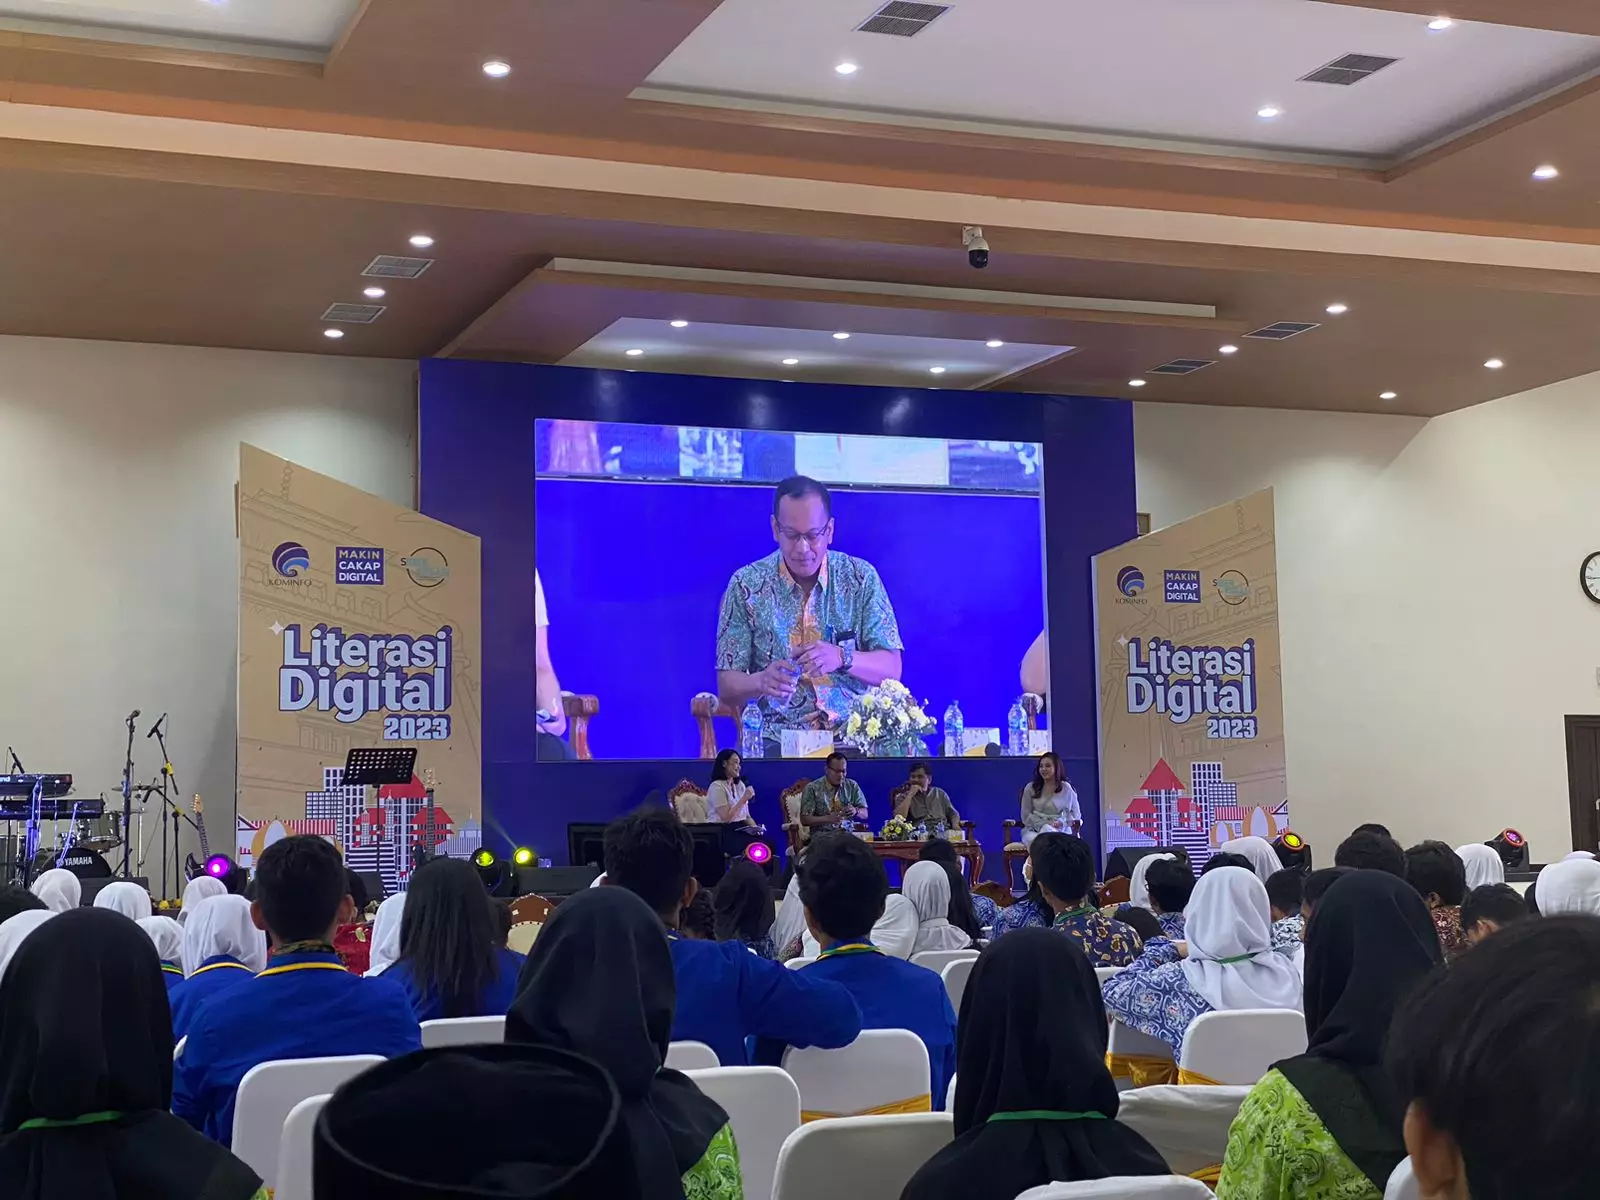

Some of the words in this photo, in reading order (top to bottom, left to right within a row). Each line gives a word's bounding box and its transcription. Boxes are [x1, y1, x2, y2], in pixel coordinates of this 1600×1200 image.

[339, 549, 380, 560] MAKIN
[339, 561, 381, 570] CAKAP
[338, 572, 381, 582] DIGITAL
[1166, 572, 1198, 581] MAKIN
[269, 578, 313, 587] KOMINFO
[1166, 582, 1199, 591] CAKAP
[1167, 592, 1199, 601] DIGITAL
[283, 624, 452, 668] Literasi
[1128, 637, 1255, 676] Literasi
[279, 667, 451, 723] Digital
[1127, 675, 1257, 724] Digital
[383, 714, 451, 740] 2023
[1206, 716, 1258, 739] 2023
[64, 856, 93, 866] YAMAHA
